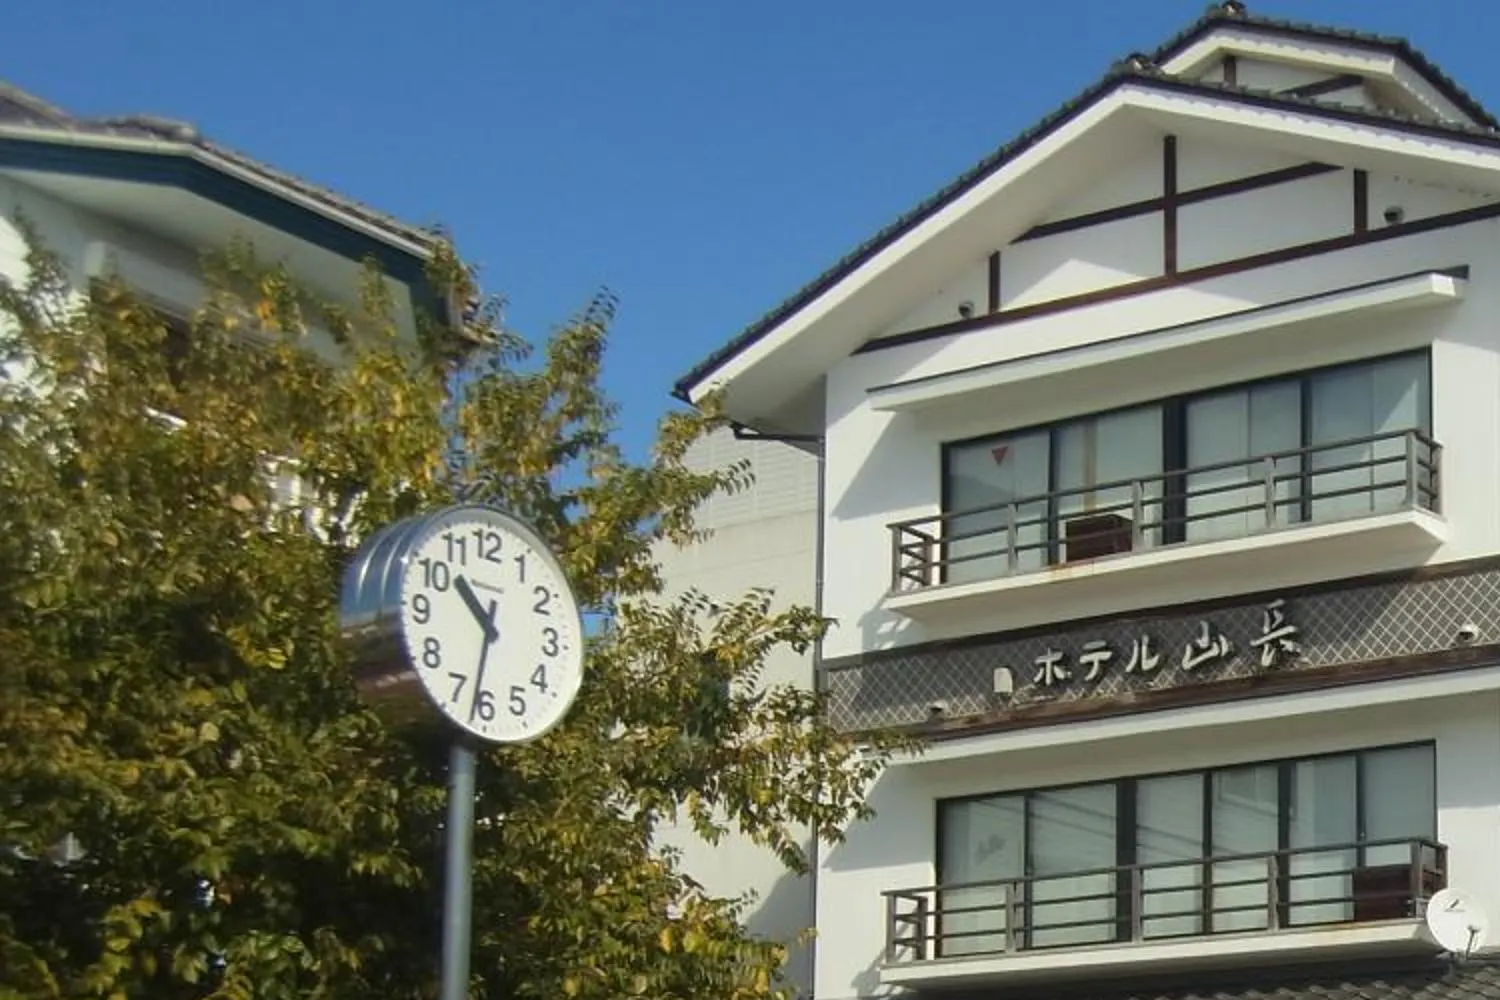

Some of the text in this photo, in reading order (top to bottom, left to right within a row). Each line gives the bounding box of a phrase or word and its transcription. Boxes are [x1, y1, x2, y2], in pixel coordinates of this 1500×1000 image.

[442, 532, 467, 566] 11
[472, 528, 502, 562] 12
[419, 558, 450, 592] 10
[514, 554, 526, 583] 1
[413, 594, 430, 624] 9
[533, 586, 550, 615] 2
[422, 637, 441, 668] 8
[541, 628, 559, 657] 3
[448, 672, 467, 702] 7
[530, 664, 548, 693] 4
[477, 690, 496, 721] 6
[509, 686, 527, 716] 5
